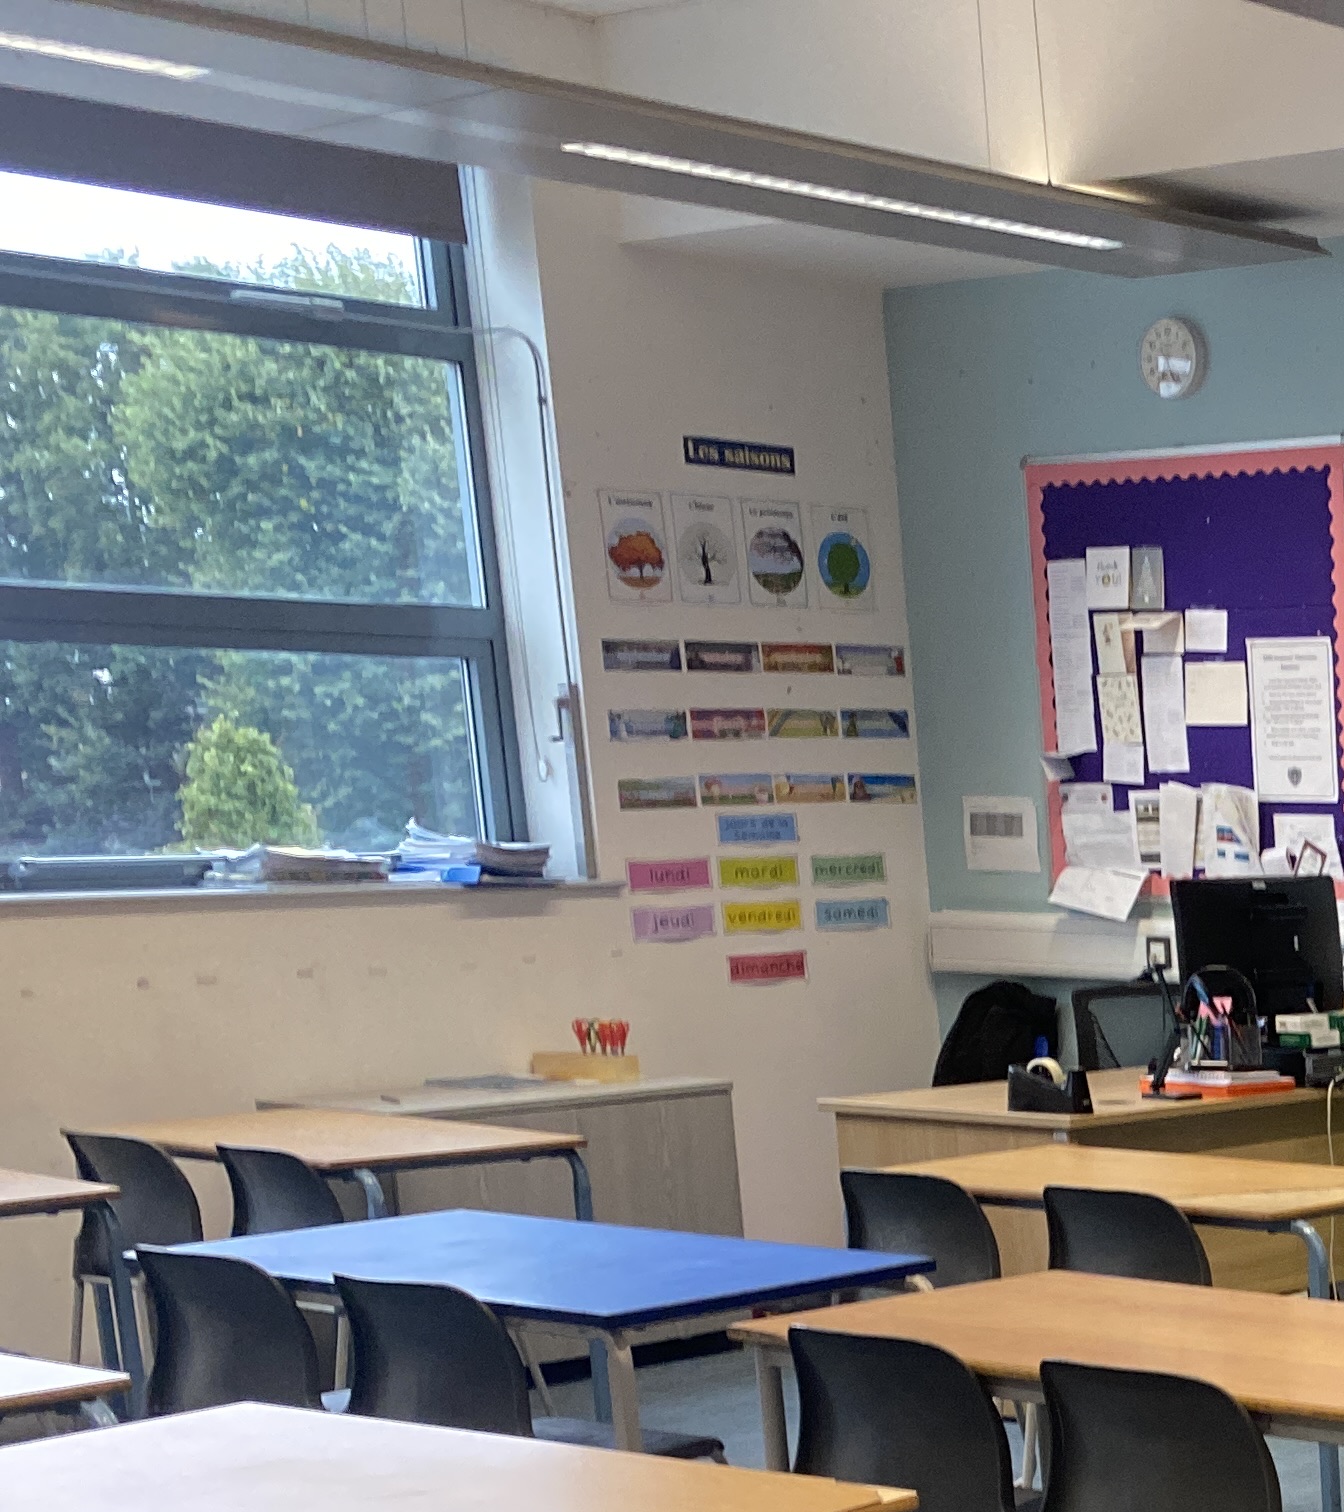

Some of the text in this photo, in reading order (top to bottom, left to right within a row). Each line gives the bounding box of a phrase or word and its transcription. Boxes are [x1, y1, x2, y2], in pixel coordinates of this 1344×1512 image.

[688, 439, 792, 470] Les saisons
[650, 866, 691, 884] lundi
[734, 863, 784, 881] mardi
[814, 859, 882, 876] mercredi
[728, 907, 796, 925] vendredi
[823, 906, 881, 923] samedi
[653, 914, 696, 935] jeudi
[729, 957, 805, 976] dimanche
